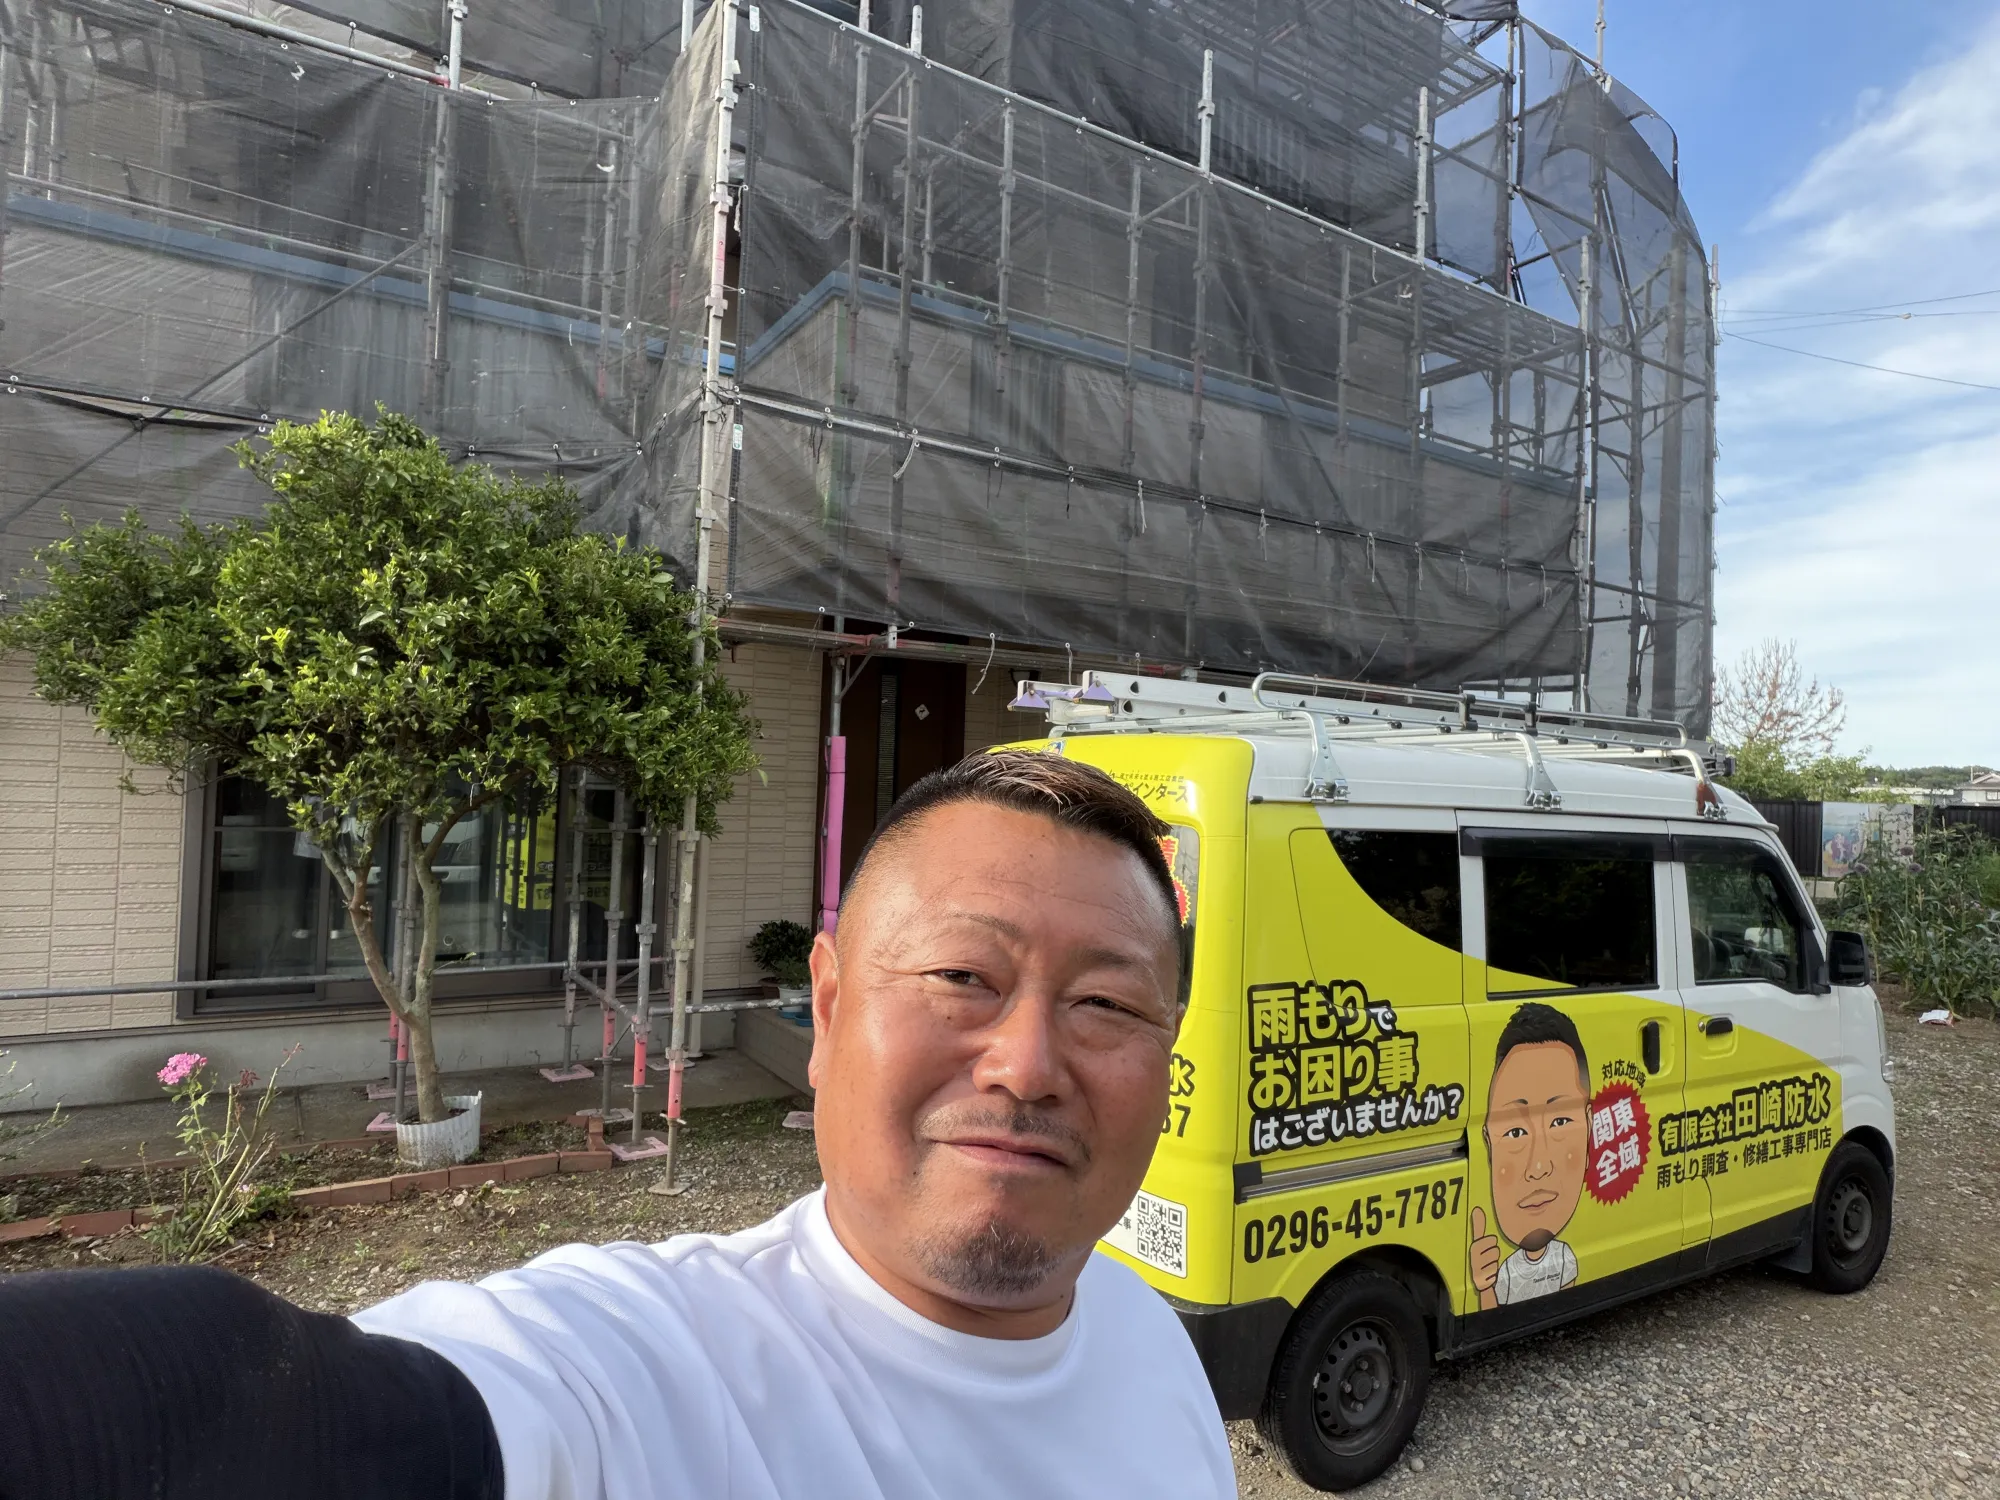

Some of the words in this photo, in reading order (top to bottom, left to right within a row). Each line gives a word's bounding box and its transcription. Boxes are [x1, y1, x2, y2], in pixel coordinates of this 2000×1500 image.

[1250, 982, 1396, 1050] 雨もりで
[1250, 1033, 1417, 1111] お困り事
[1602, 1059, 1647, 1089] 対応地域
[1251, 1086, 1463, 1153] はございませんか?
[1592, 1096, 1637, 1149] 関東
[1596, 1133, 1640, 1188] 全域
[1243, 1176, 1464, 1263] 0296-45-7787
